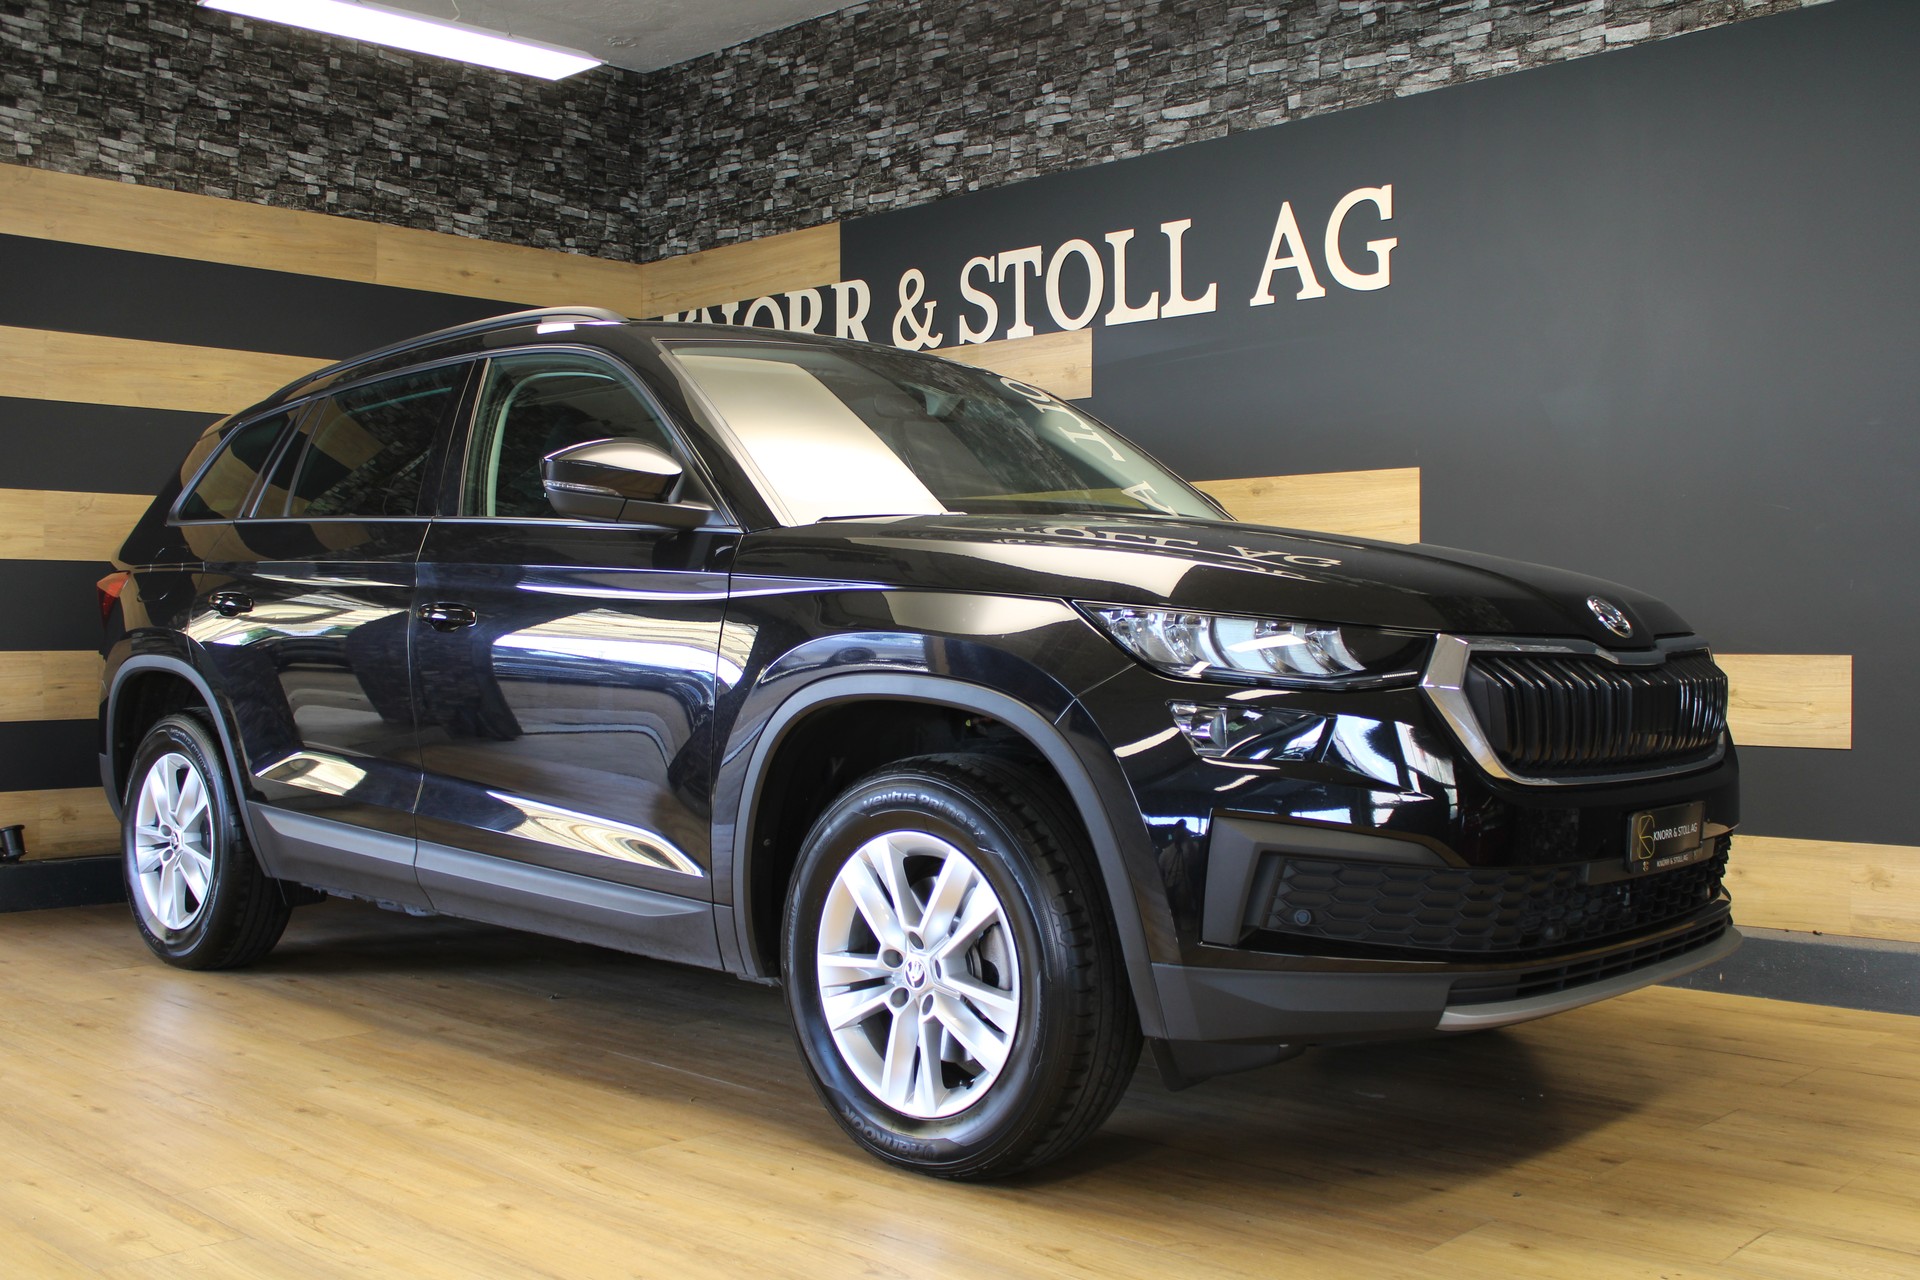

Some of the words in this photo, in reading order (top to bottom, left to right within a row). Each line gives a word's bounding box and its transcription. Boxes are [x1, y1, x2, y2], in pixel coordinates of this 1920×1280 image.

[893, 269, 943, 351] &
[959, 219, 1217, 346] STOLL
[1249, 184, 1398, 307] AG
[1653, 828, 1673, 841] KNORR
[1673, 827, 1678, 837] &
[1677, 824, 1691, 837] STOLL
[1690, 822, 1698, 833] AG
